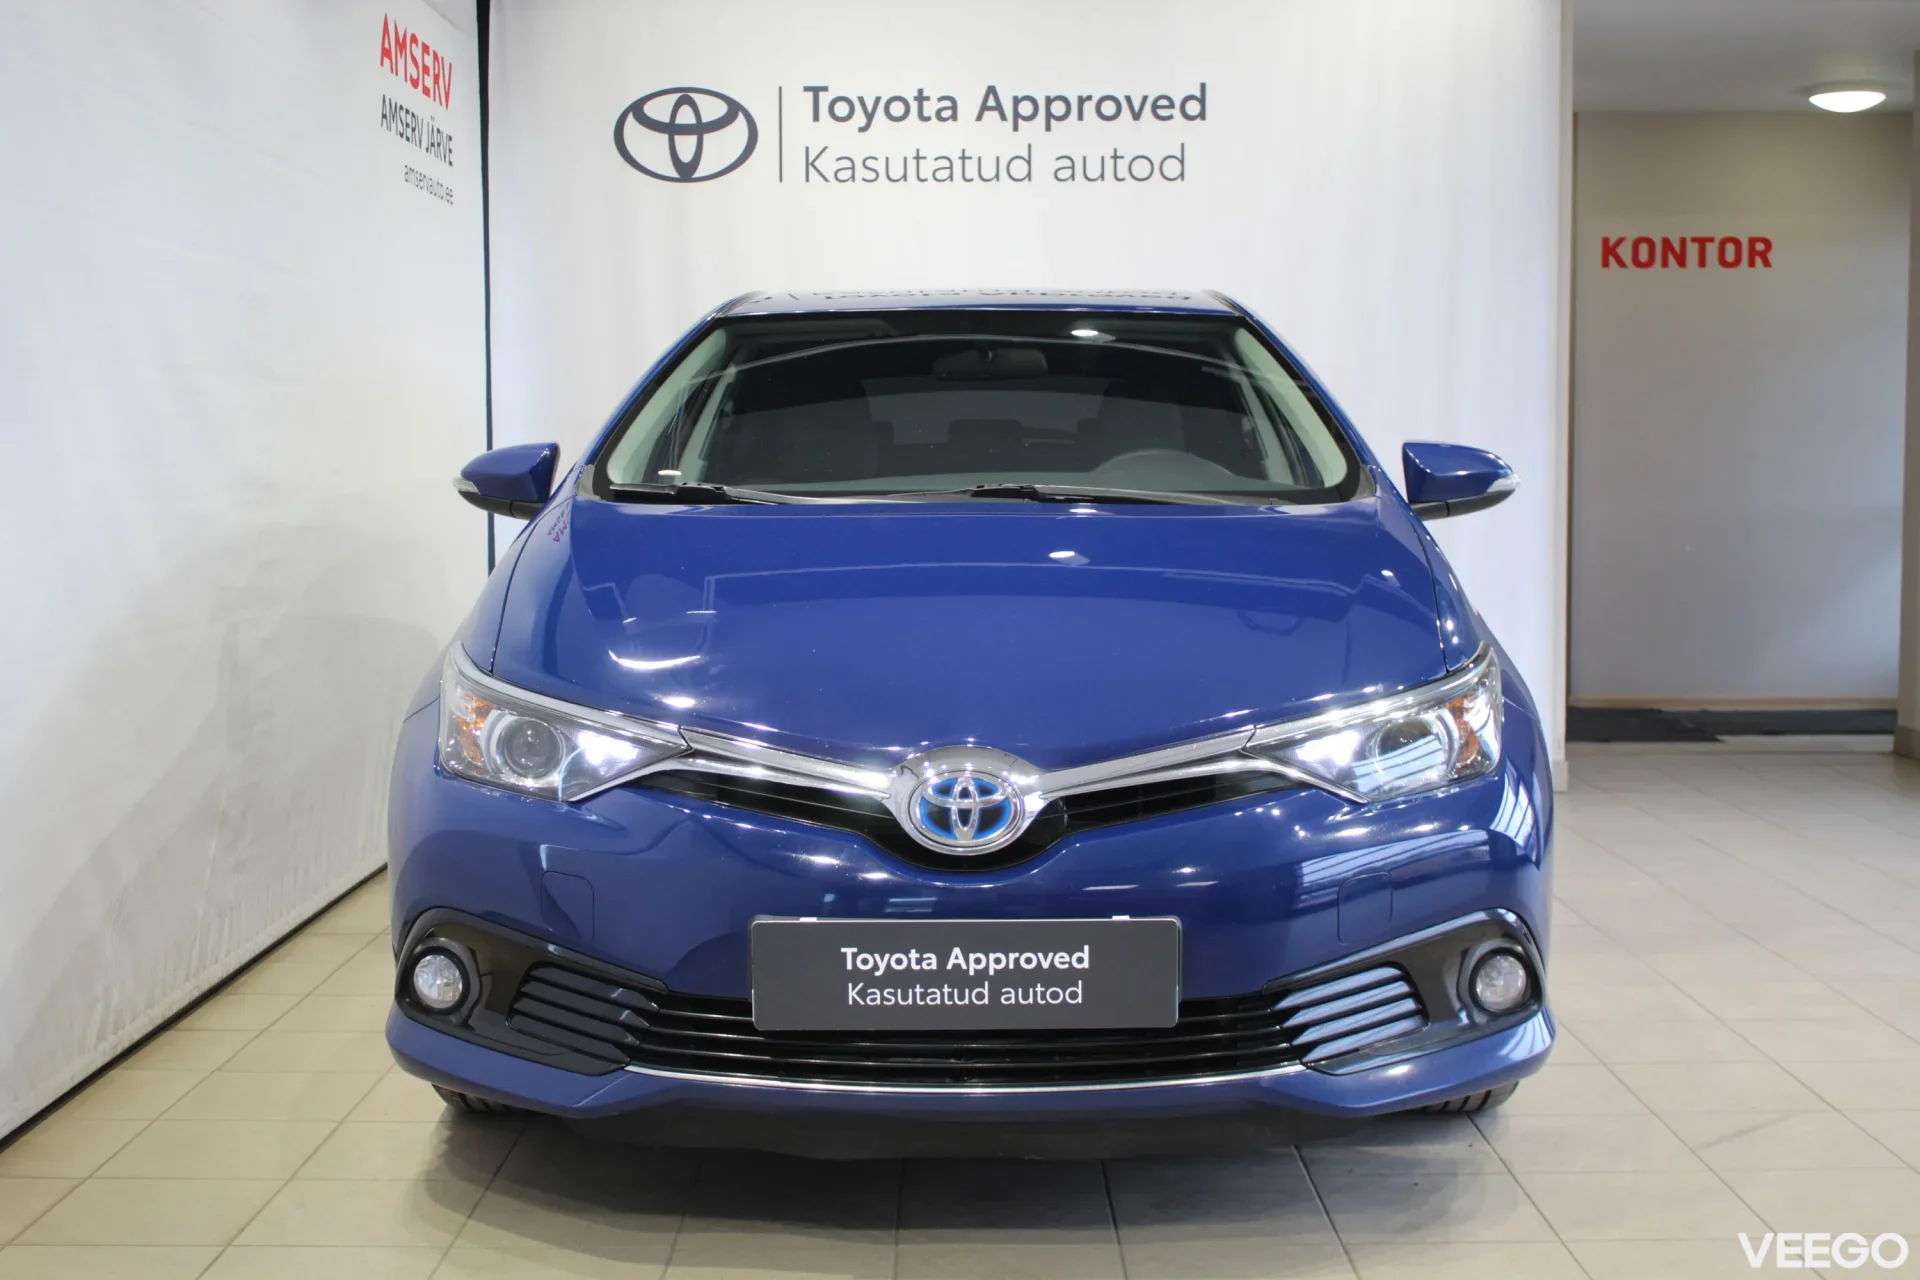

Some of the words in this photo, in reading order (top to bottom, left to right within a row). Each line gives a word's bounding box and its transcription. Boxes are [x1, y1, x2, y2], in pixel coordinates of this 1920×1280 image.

[380, 12, 452, 111] AMSERV
[803, 84, 959, 132] Toyota
[976, 82, 1207, 132] Approved
[381, 93, 424, 150] AMSERV
[425, 114, 453, 167] JÄRVE
[804, 143, 1032, 183] Kasutatud
[1053, 143, 1185, 183] autod
[404, 164, 454, 205] amservauto.ee
[1601, 236, 1773, 269] KONTOR
[841, 946, 937, 976] Toyota
[946, 944, 1090, 976] Approved
[847, 981, 989, 1006] Kasutatud
[1000, 980, 1083, 1005] autod
